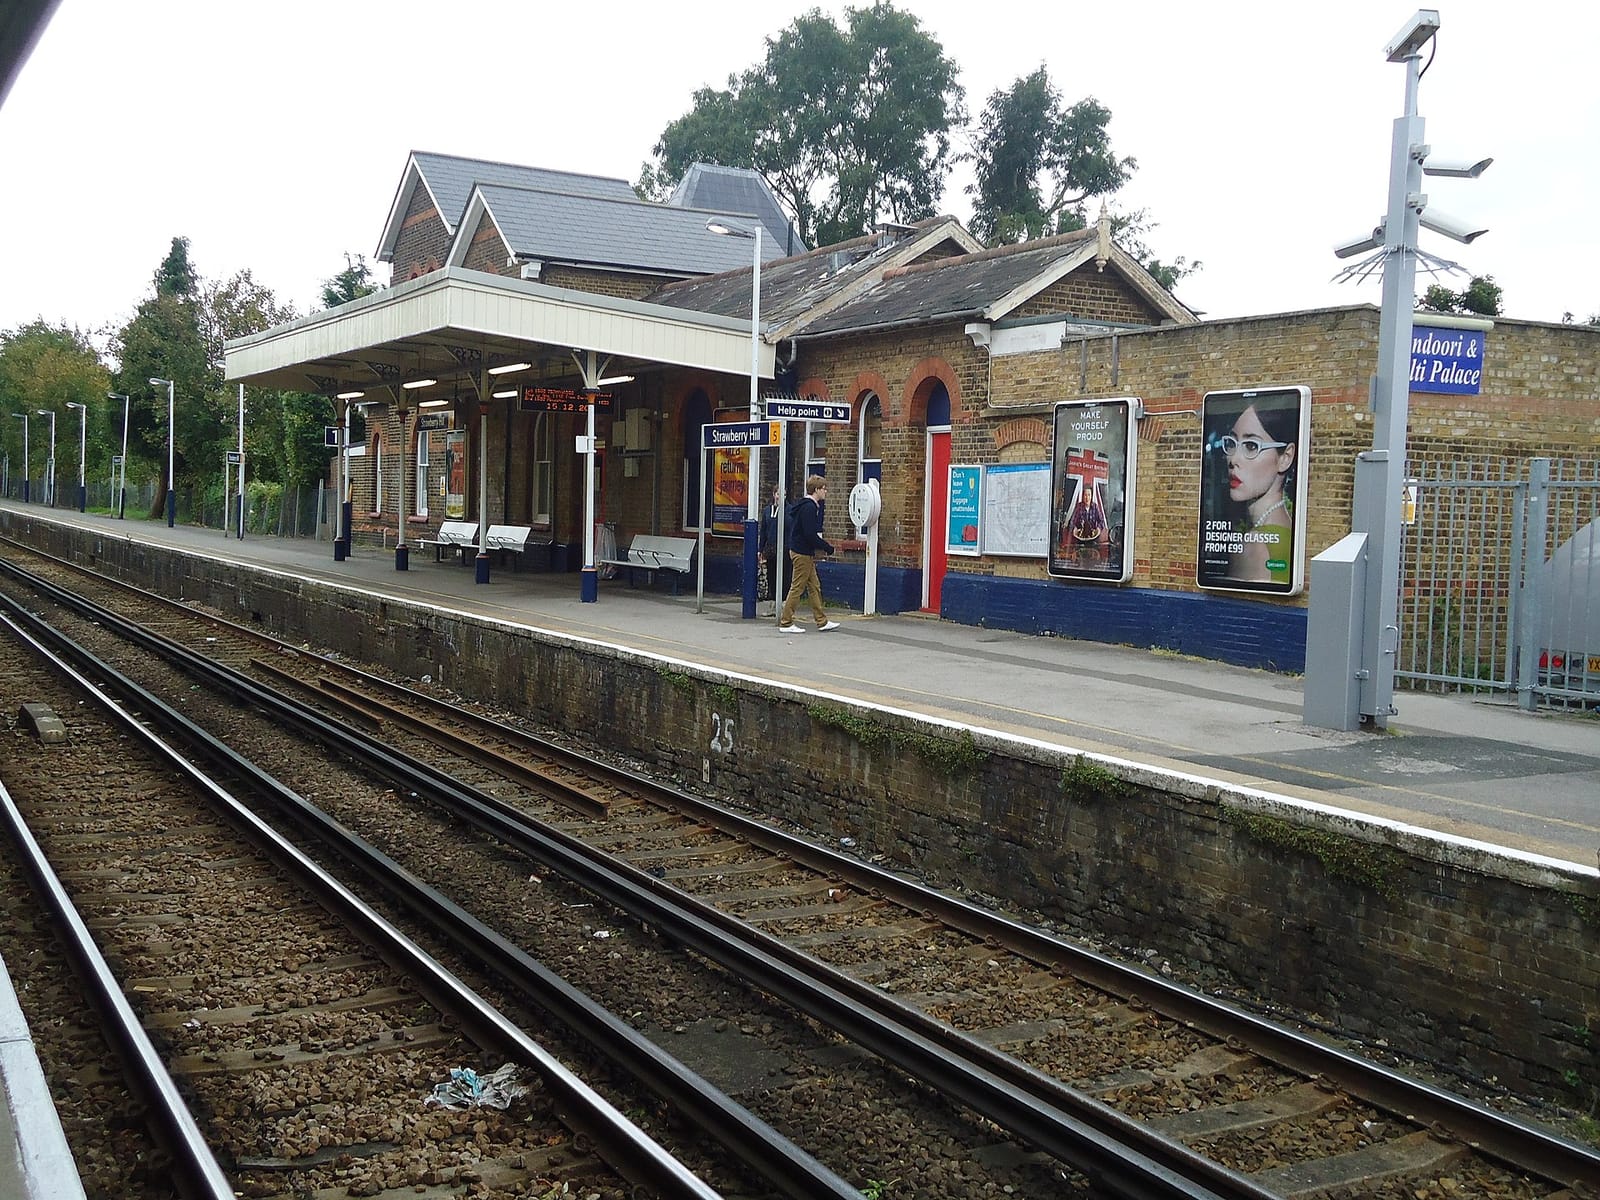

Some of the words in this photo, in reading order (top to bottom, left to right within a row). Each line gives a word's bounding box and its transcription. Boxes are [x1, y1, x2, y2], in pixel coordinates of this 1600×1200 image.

[1466, 339, 1477, 358] &
[1429, 360, 1480, 385] Palace
[777, 405, 797, 417] Help
[797, 407, 819, 418] point
[1080, 411, 1101, 420] MAKE
[1070, 421, 1110, 431] YOURSELF
[332, 430, 337, 444] 1
[712, 430, 748, 444] Strawberry
[749, 427, 761, 441] Hill
[1076, 432, 1103, 441] PROUD
[1206, 521, 1212, 530] 2
[1212, 521, 1227, 530] FOR
[1227, 521, 1232, 530] 1
[1206, 532, 1243, 542] DESIGNER
[1244, 533, 1280, 544] GLASSES
[1205, 543, 1227, 553] FROM
[1228, 544, 1244, 553] £99
